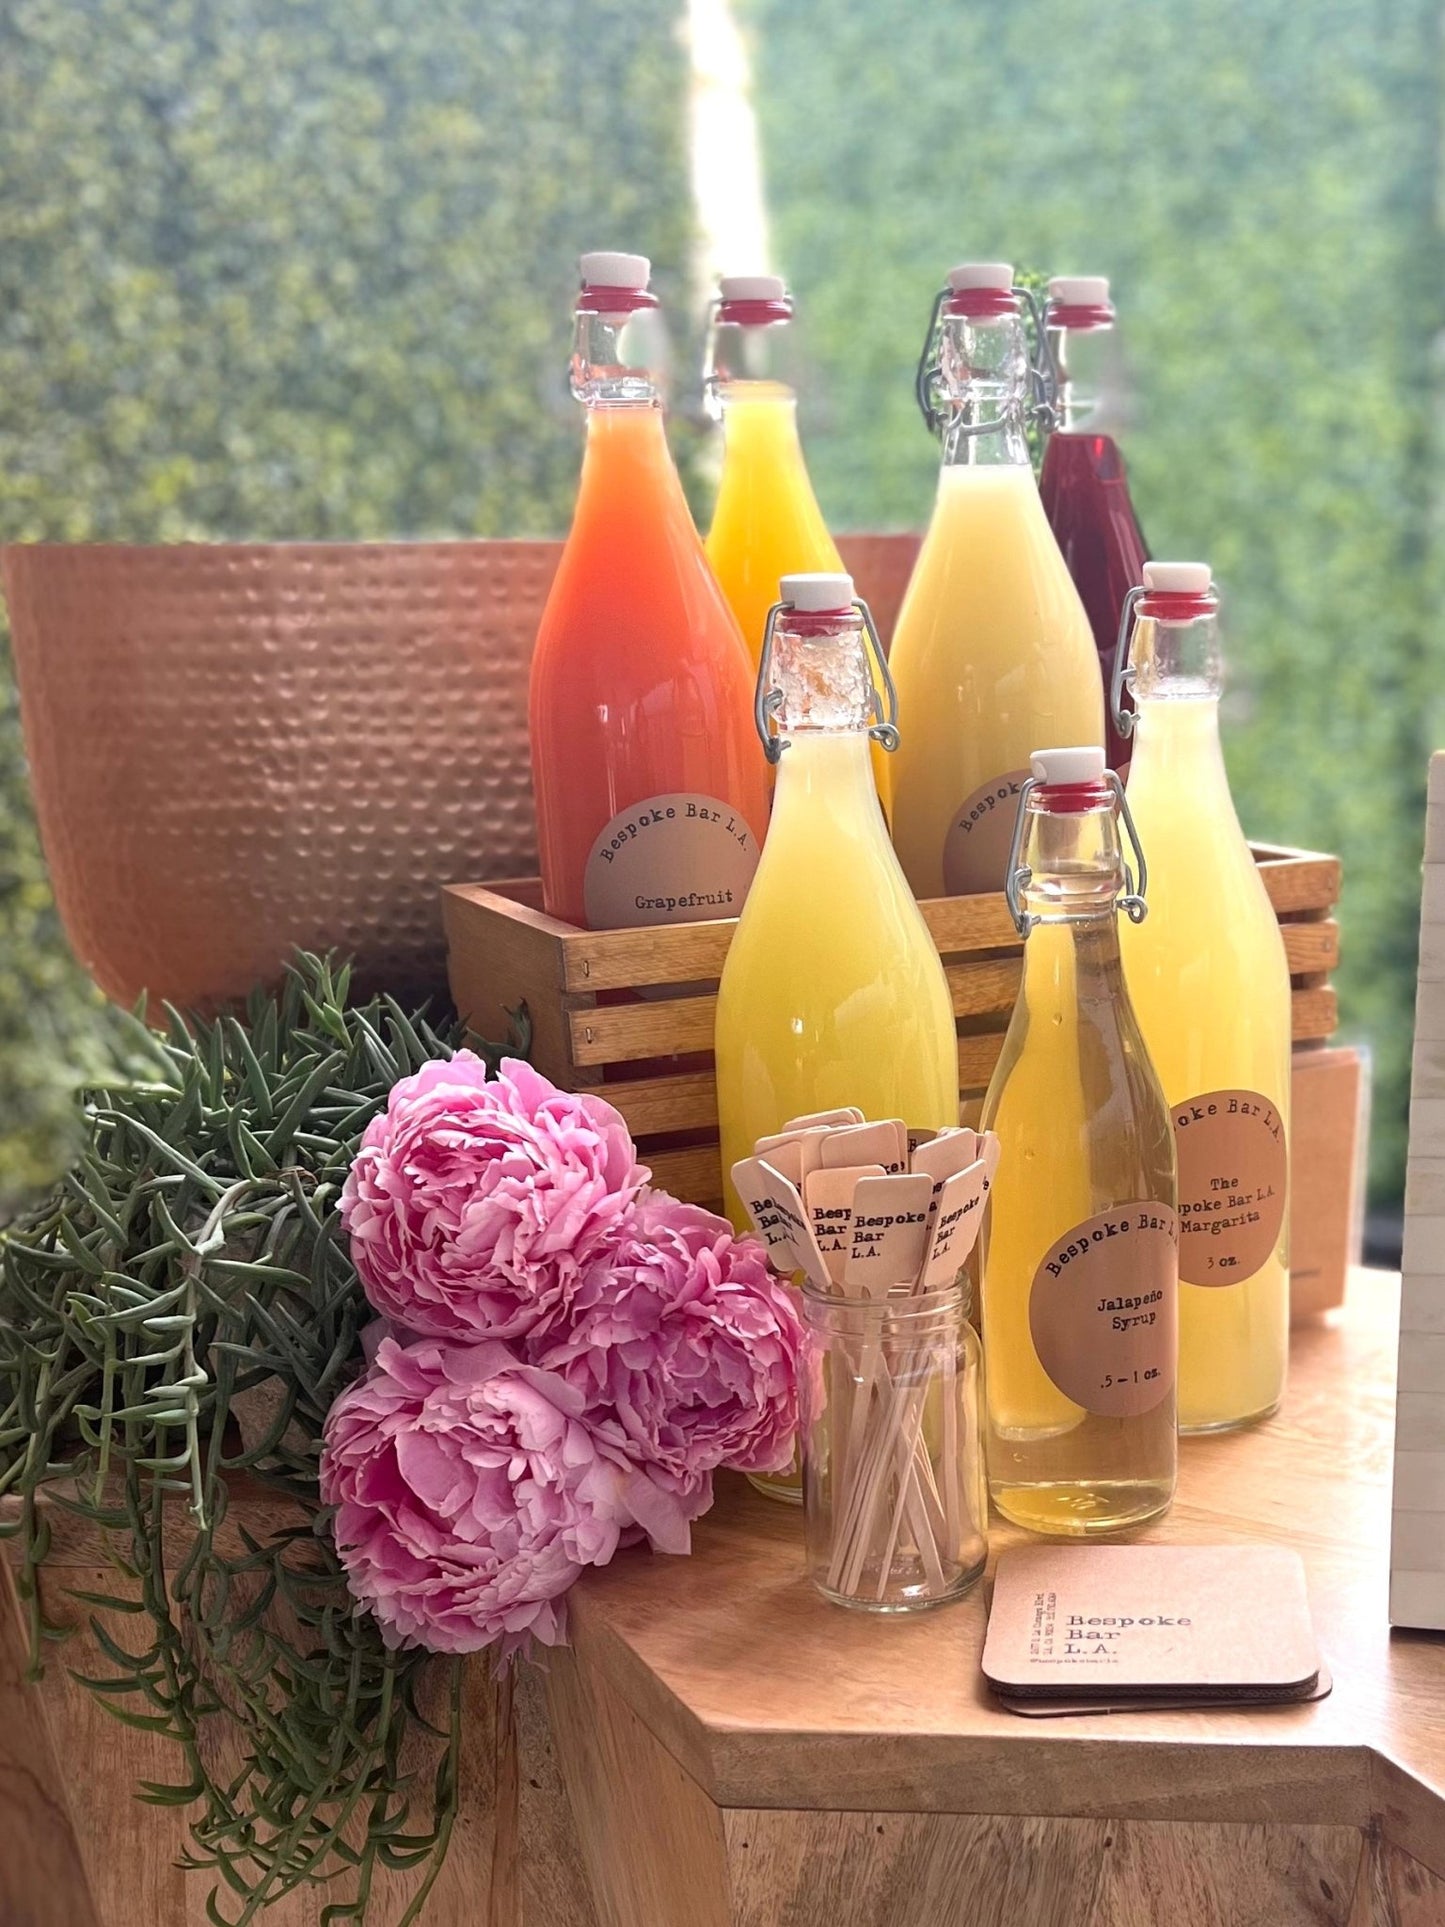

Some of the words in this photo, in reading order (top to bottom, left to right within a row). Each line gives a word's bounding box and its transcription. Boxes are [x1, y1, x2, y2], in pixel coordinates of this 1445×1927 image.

[959, 781, 1020, 832] Bespok
[600, 807, 675, 863] Bespoke
[685, 803, 721, 823] Bar
[726, 818, 747, 851] L.A.
[635, 889, 733, 911] Grapefruit
[1226, 1099, 1260, 1117] Bar
[1210, 1177, 1239, 1191] The
[1227, 1193, 1253, 1209] Bar
[813, 1208, 852, 1220] Besp
[854, 1212, 926, 1228] Bespoke
[938, 1196, 980, 1229] Bespoke
[815, 1224, 847, 1236] Bar
[1181, 1210, 1260, 1235] Margarita
[852, 1232, 885, 1243] Bar
[935, 1226, 956, 1245] Bar
[817, 1239, 847, 1251] L.A.
[851, 1246, 881, 1259] L.A.
[1045, 1218, 1130, 1278] Bespoke
[1137, 1214, 1166, 1230] Bar
[1207, 1257, 1215, 1270] 3
[1218, 1256, 1240, 1267] oz.
[1112, 1312, 1156, 1332] Syrup
[1143, 1368, 1161, 1381] oz.
[1066, 1615, 1192, 1628] Bespoke
[1065, 1629, 1121, 1640] Bar
[1064, 1643, 1118, 1655] L.A.
